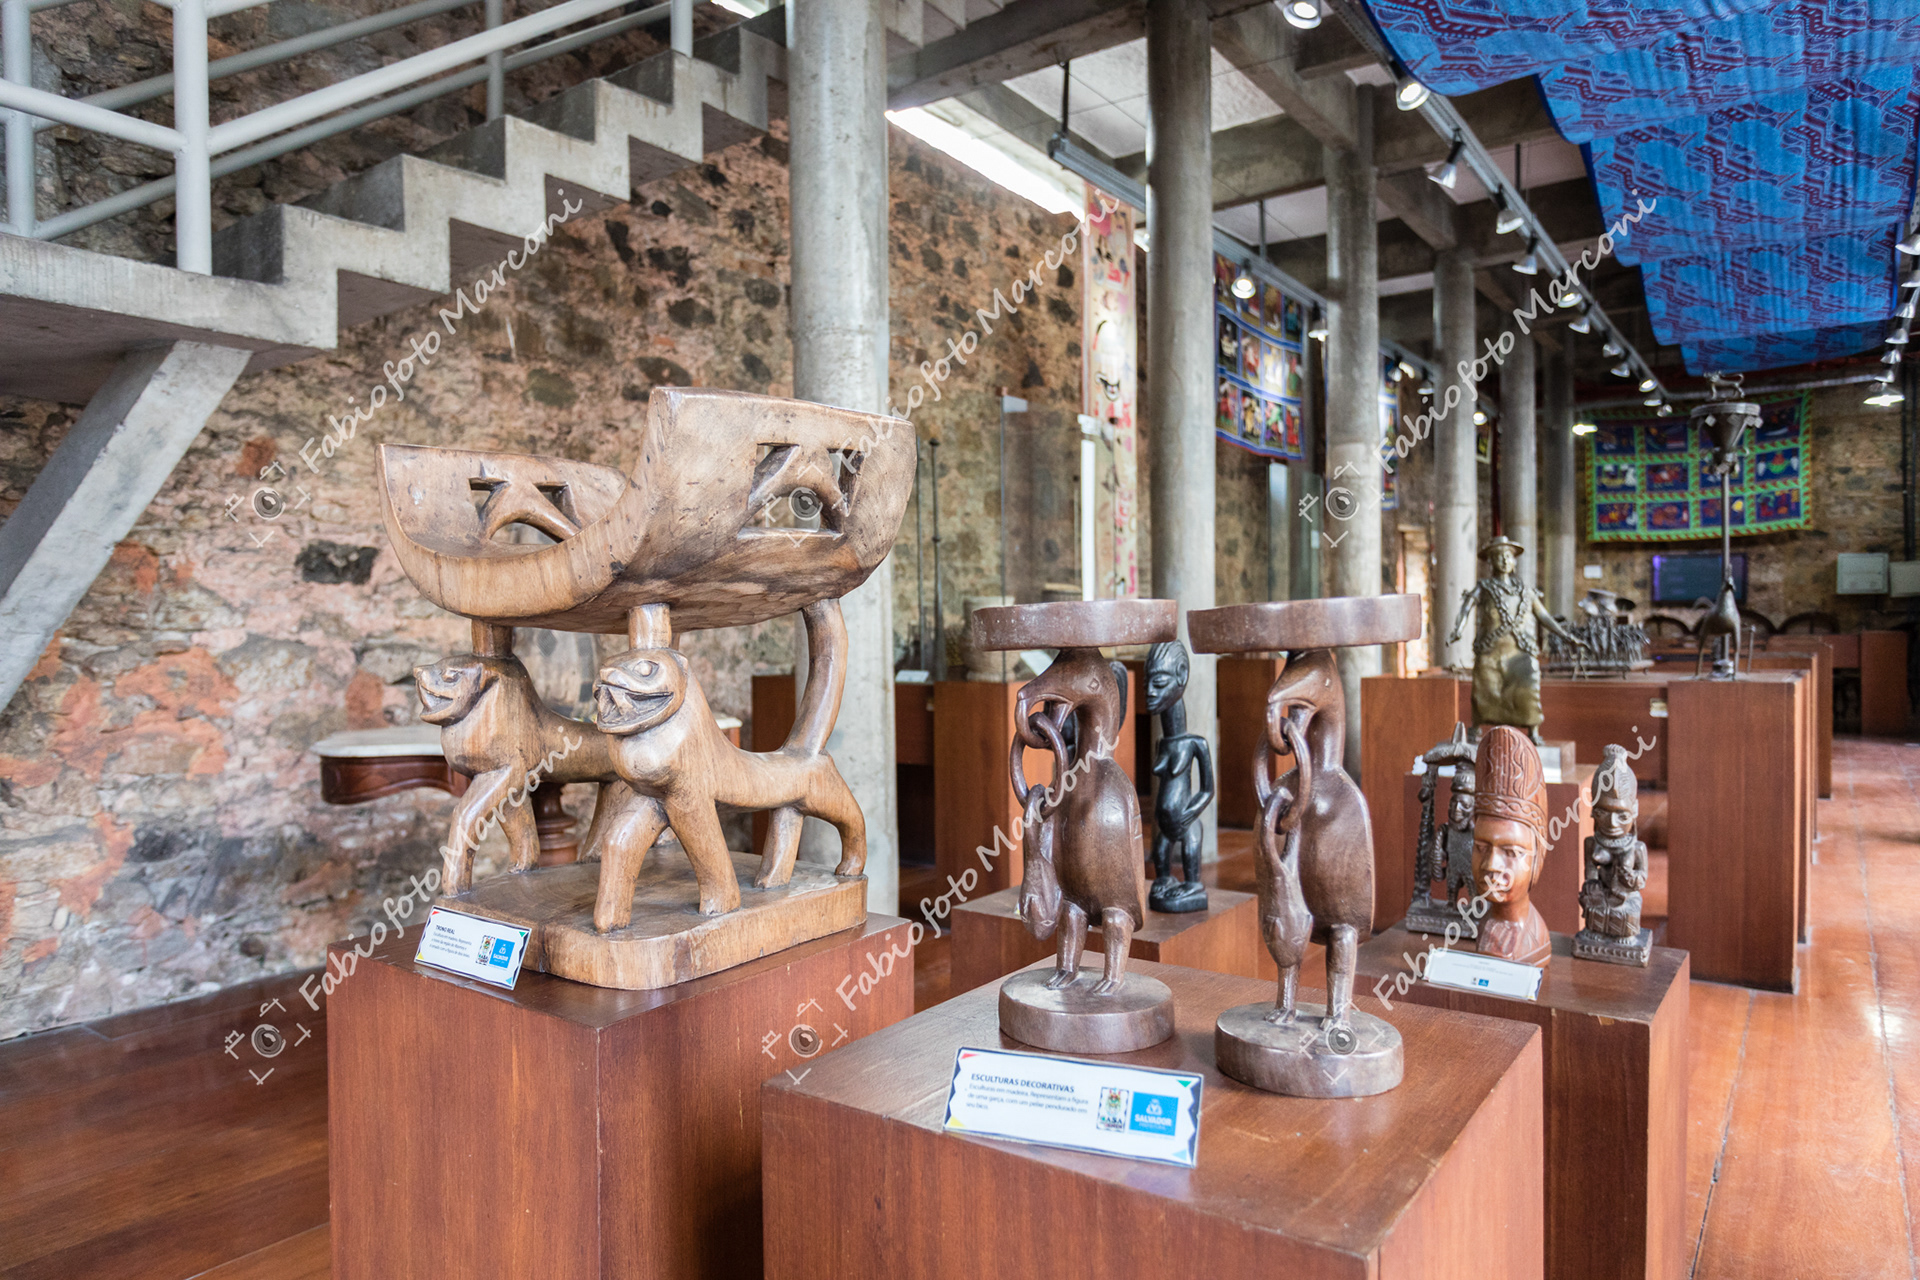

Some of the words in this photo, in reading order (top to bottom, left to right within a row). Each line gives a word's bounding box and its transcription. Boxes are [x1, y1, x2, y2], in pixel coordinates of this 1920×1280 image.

[969, 1083, 995, 1092] Esculturas
[971, 1073, 1019, 1086] ESCULTURAS
[1020, 1079, 1075, 1093] DECORATIVAS
[1135, 1113, 1172, 1126] SALVADOR
